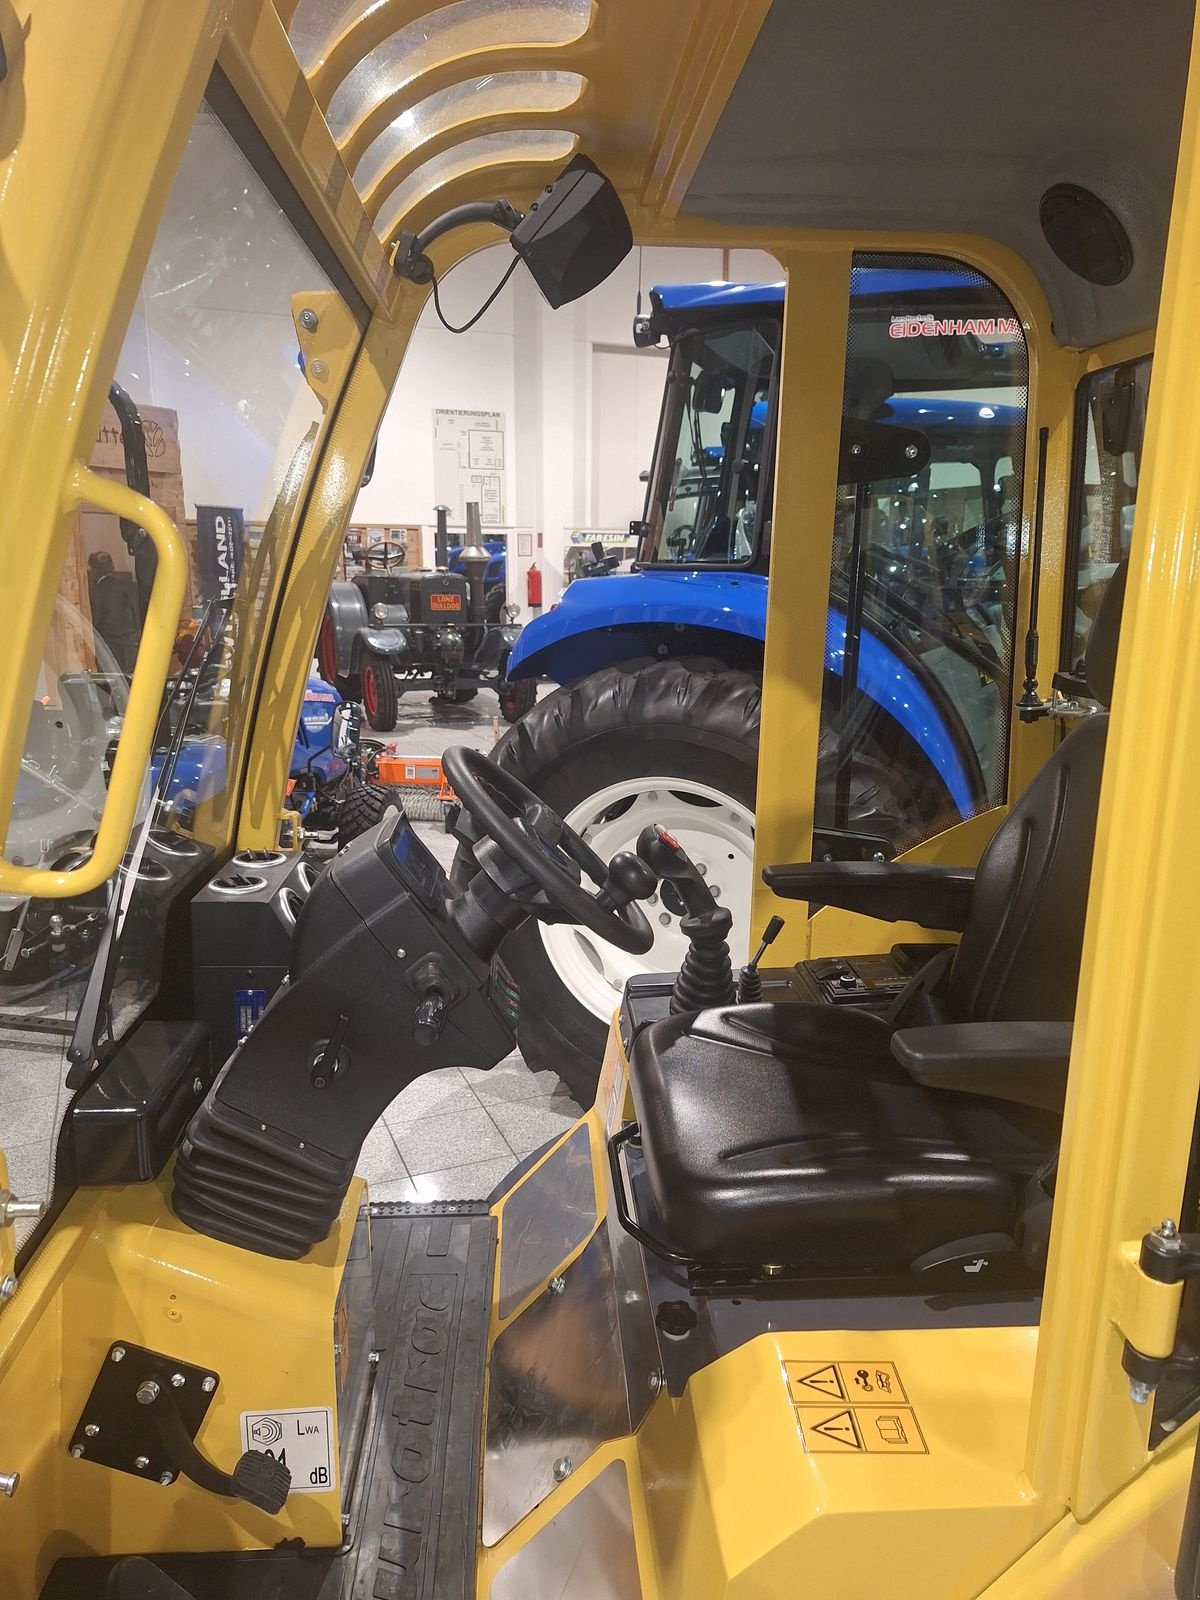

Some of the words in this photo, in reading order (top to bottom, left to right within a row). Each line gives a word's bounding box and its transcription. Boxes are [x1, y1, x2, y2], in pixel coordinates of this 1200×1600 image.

[435, 408, 501, 418] ORIENTIERUNGSPLAN
[585, 534, 624, 542] FARESIN
[309, 1466, 329, 1485] dB
